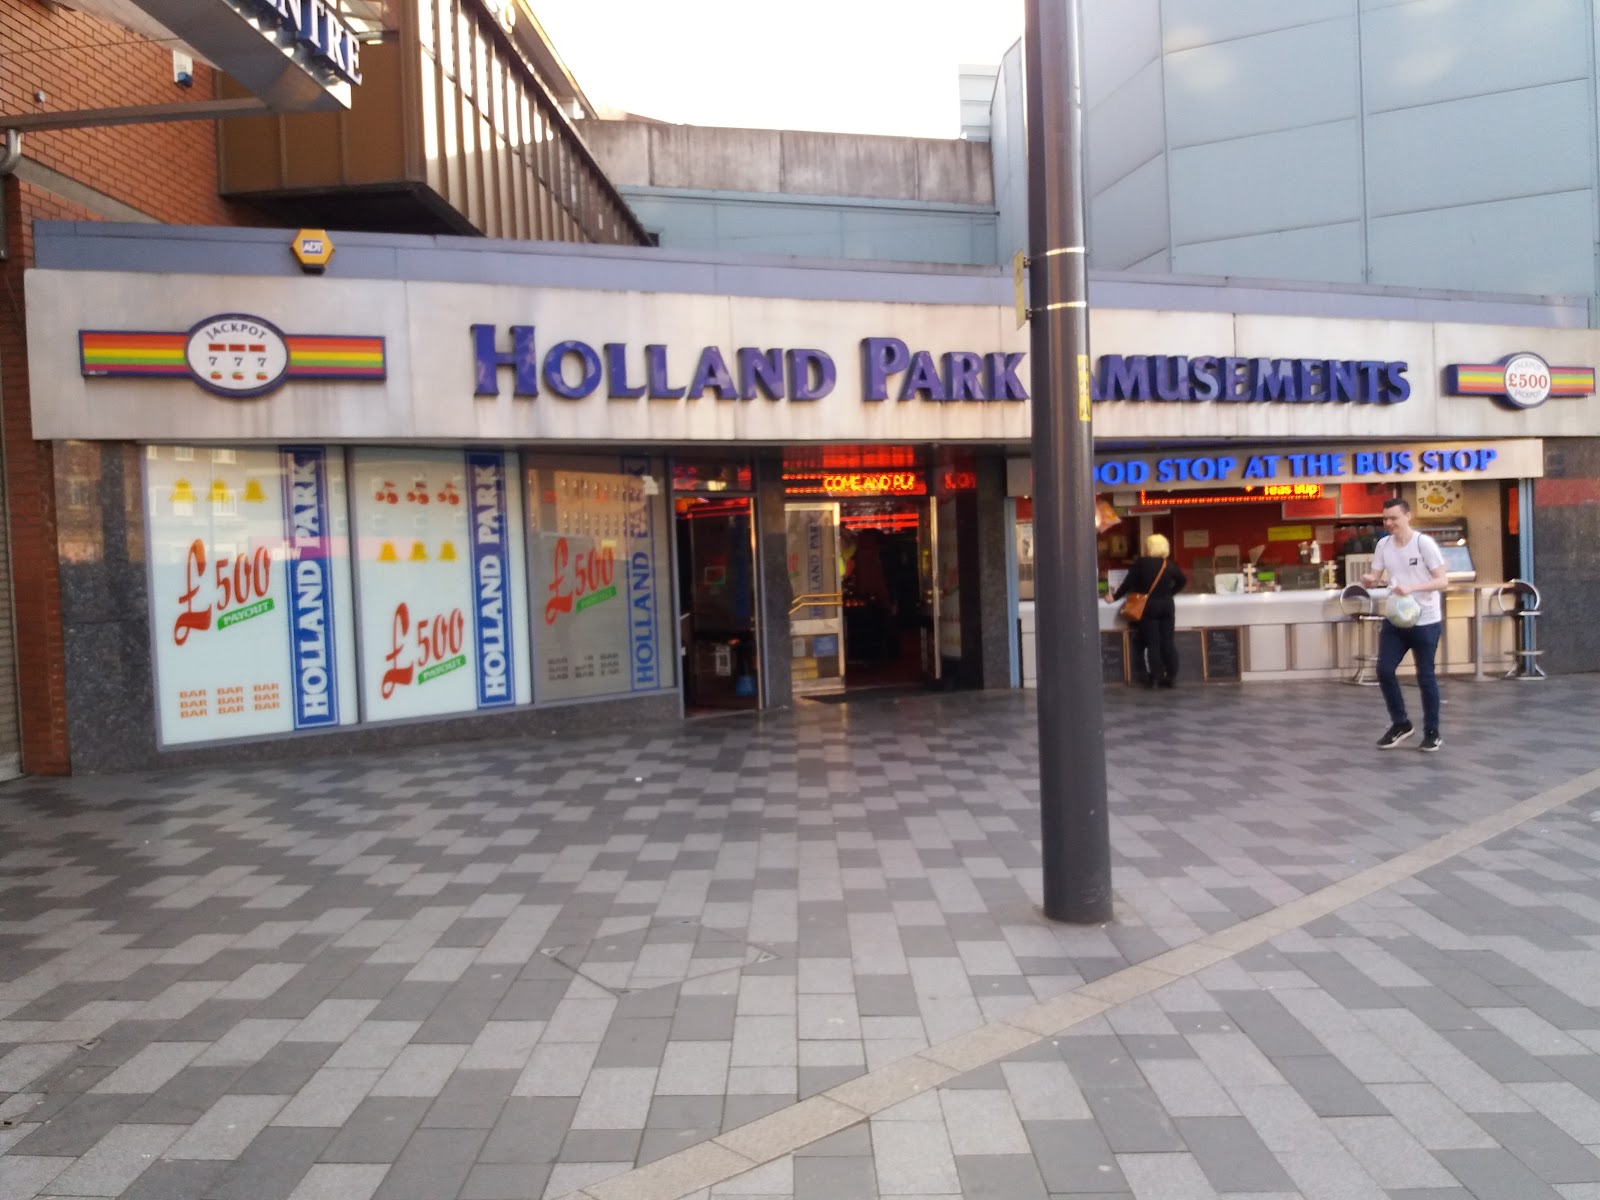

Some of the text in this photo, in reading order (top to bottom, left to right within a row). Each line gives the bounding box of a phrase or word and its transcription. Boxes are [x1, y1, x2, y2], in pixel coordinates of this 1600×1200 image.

[265, 0, 362, 86] NTRE
[206, 323, 267, 340] JACKPOT
[470, 324, 837, 401] HOLLAND
[859, 337, 1030, 402] PARK
[1091, 354, 1411, 404] MUSEMENTS
[1508, 373, 1548, 389] £500
[824, 474, 861, 491] COME
[863, 474, 891, 491] AND
[1093, 448, 1498, 485] OD STOP AT THE BUS STOP
[174, 538, 272, 647] £500
[475, 464, 507, 699] HOLLAND PARK
[222, 600, 270, 627] PAYOUT
[632, 551, 654, 683] HOLLAND
[296, 560, 329, 718] HOLLAND
[381, 602, 465, 700] £500
[179, 683, 279, 698] BAR BAR BAR
[180, 693, 280, 708] BAR BAR BAR
[181, 702, 280, 718] BAR BAR BAR
